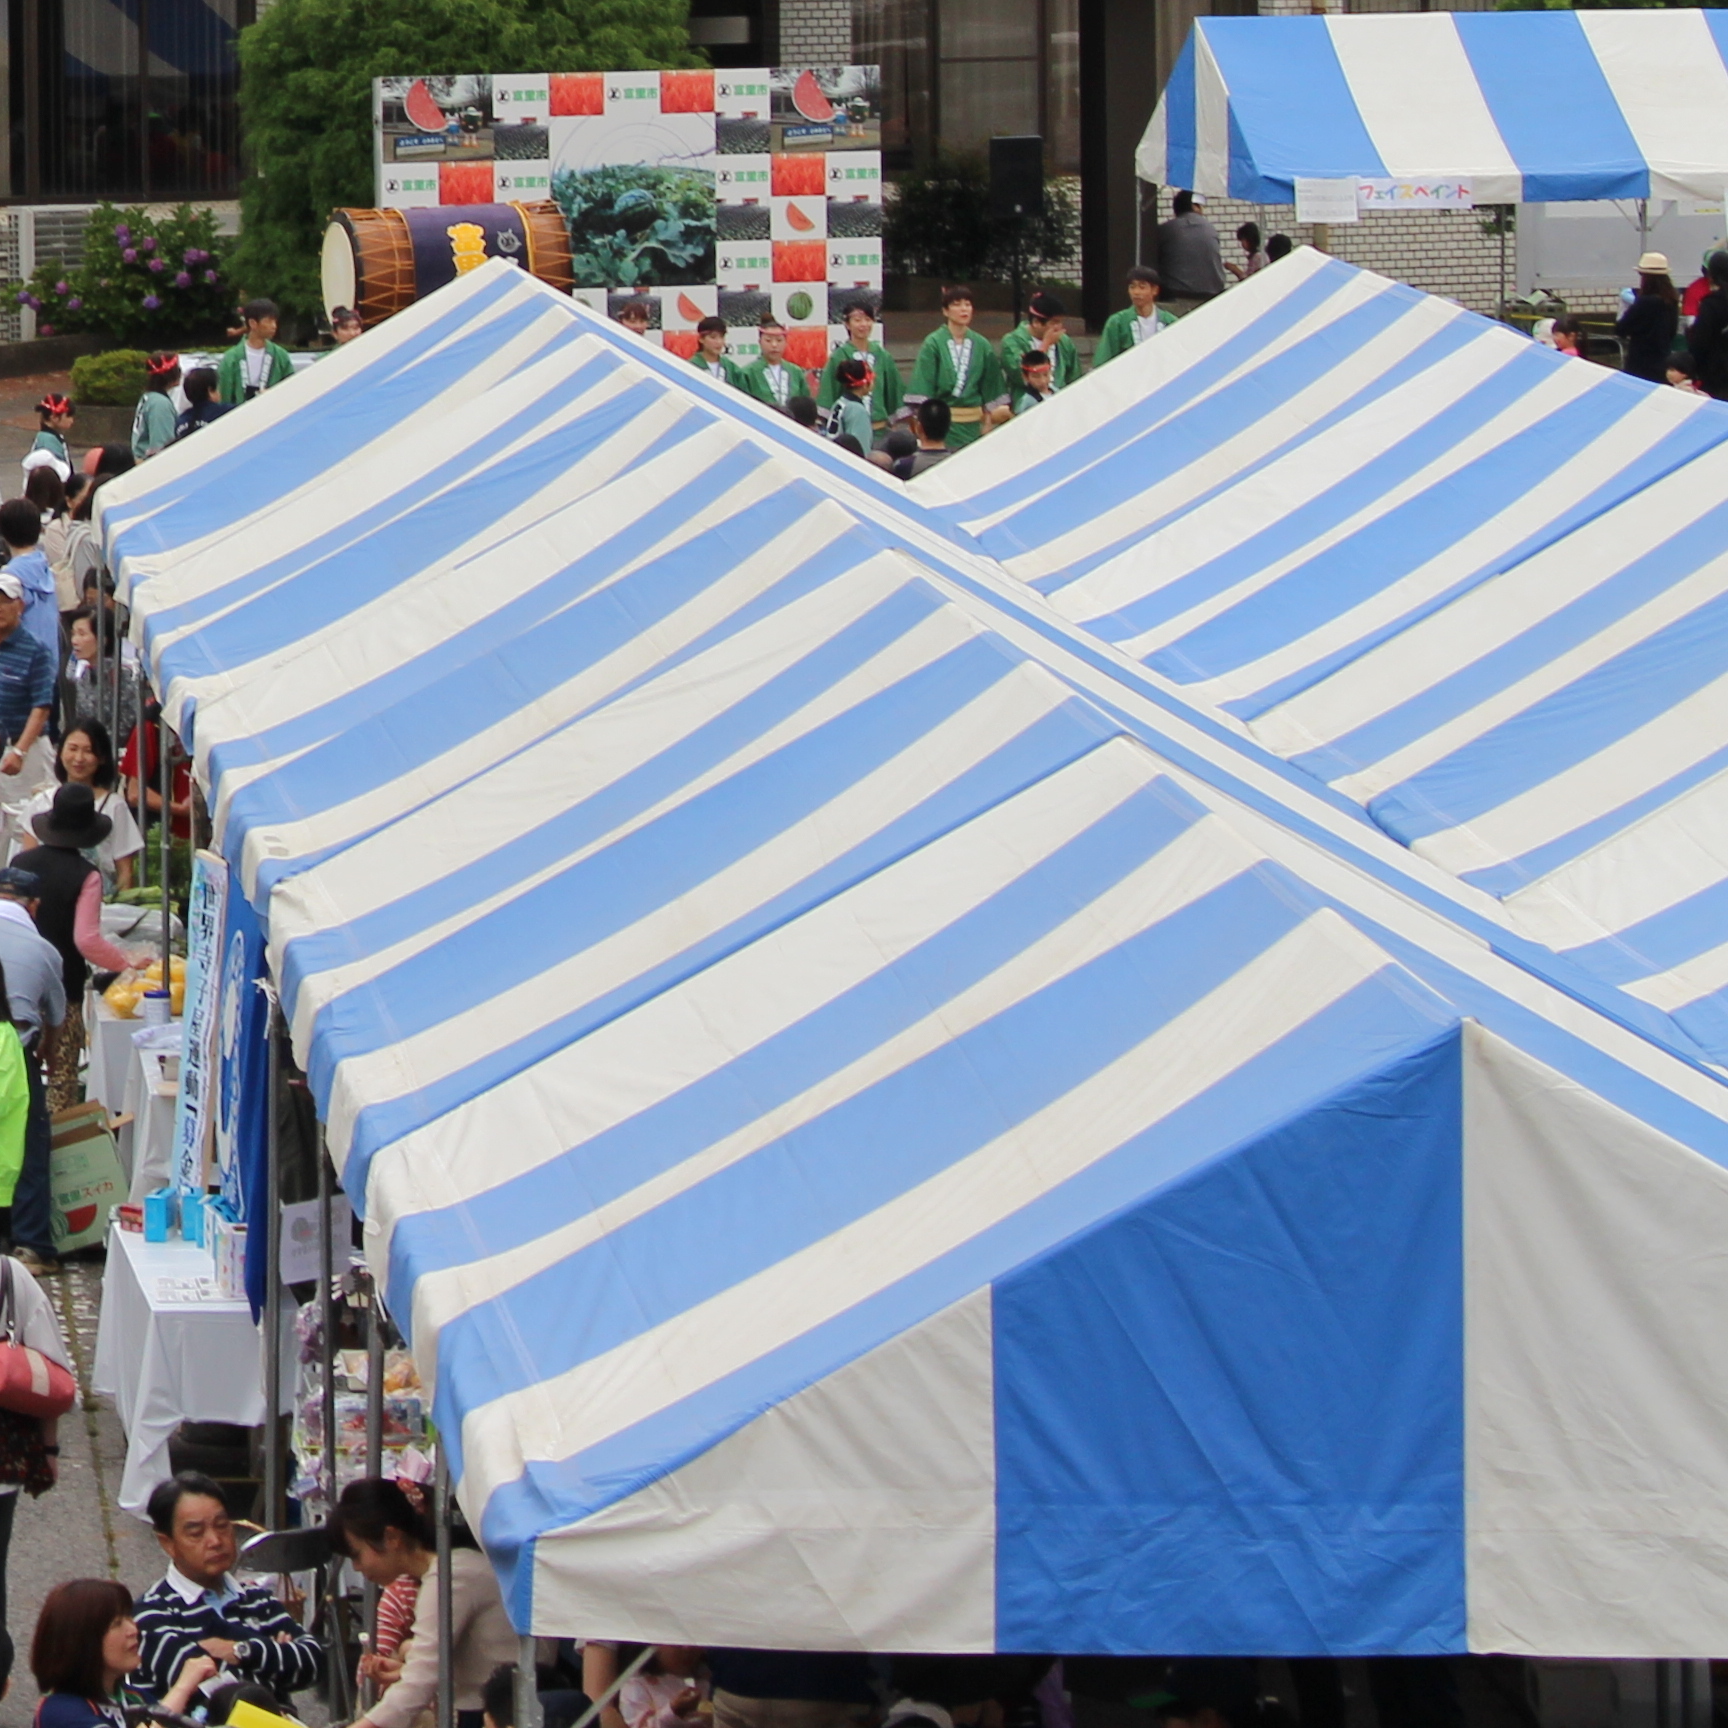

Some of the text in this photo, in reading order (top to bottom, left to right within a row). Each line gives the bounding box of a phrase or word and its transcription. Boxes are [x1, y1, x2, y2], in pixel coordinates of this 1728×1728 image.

[1359, 184, 1470, 200] フェイスペイント
